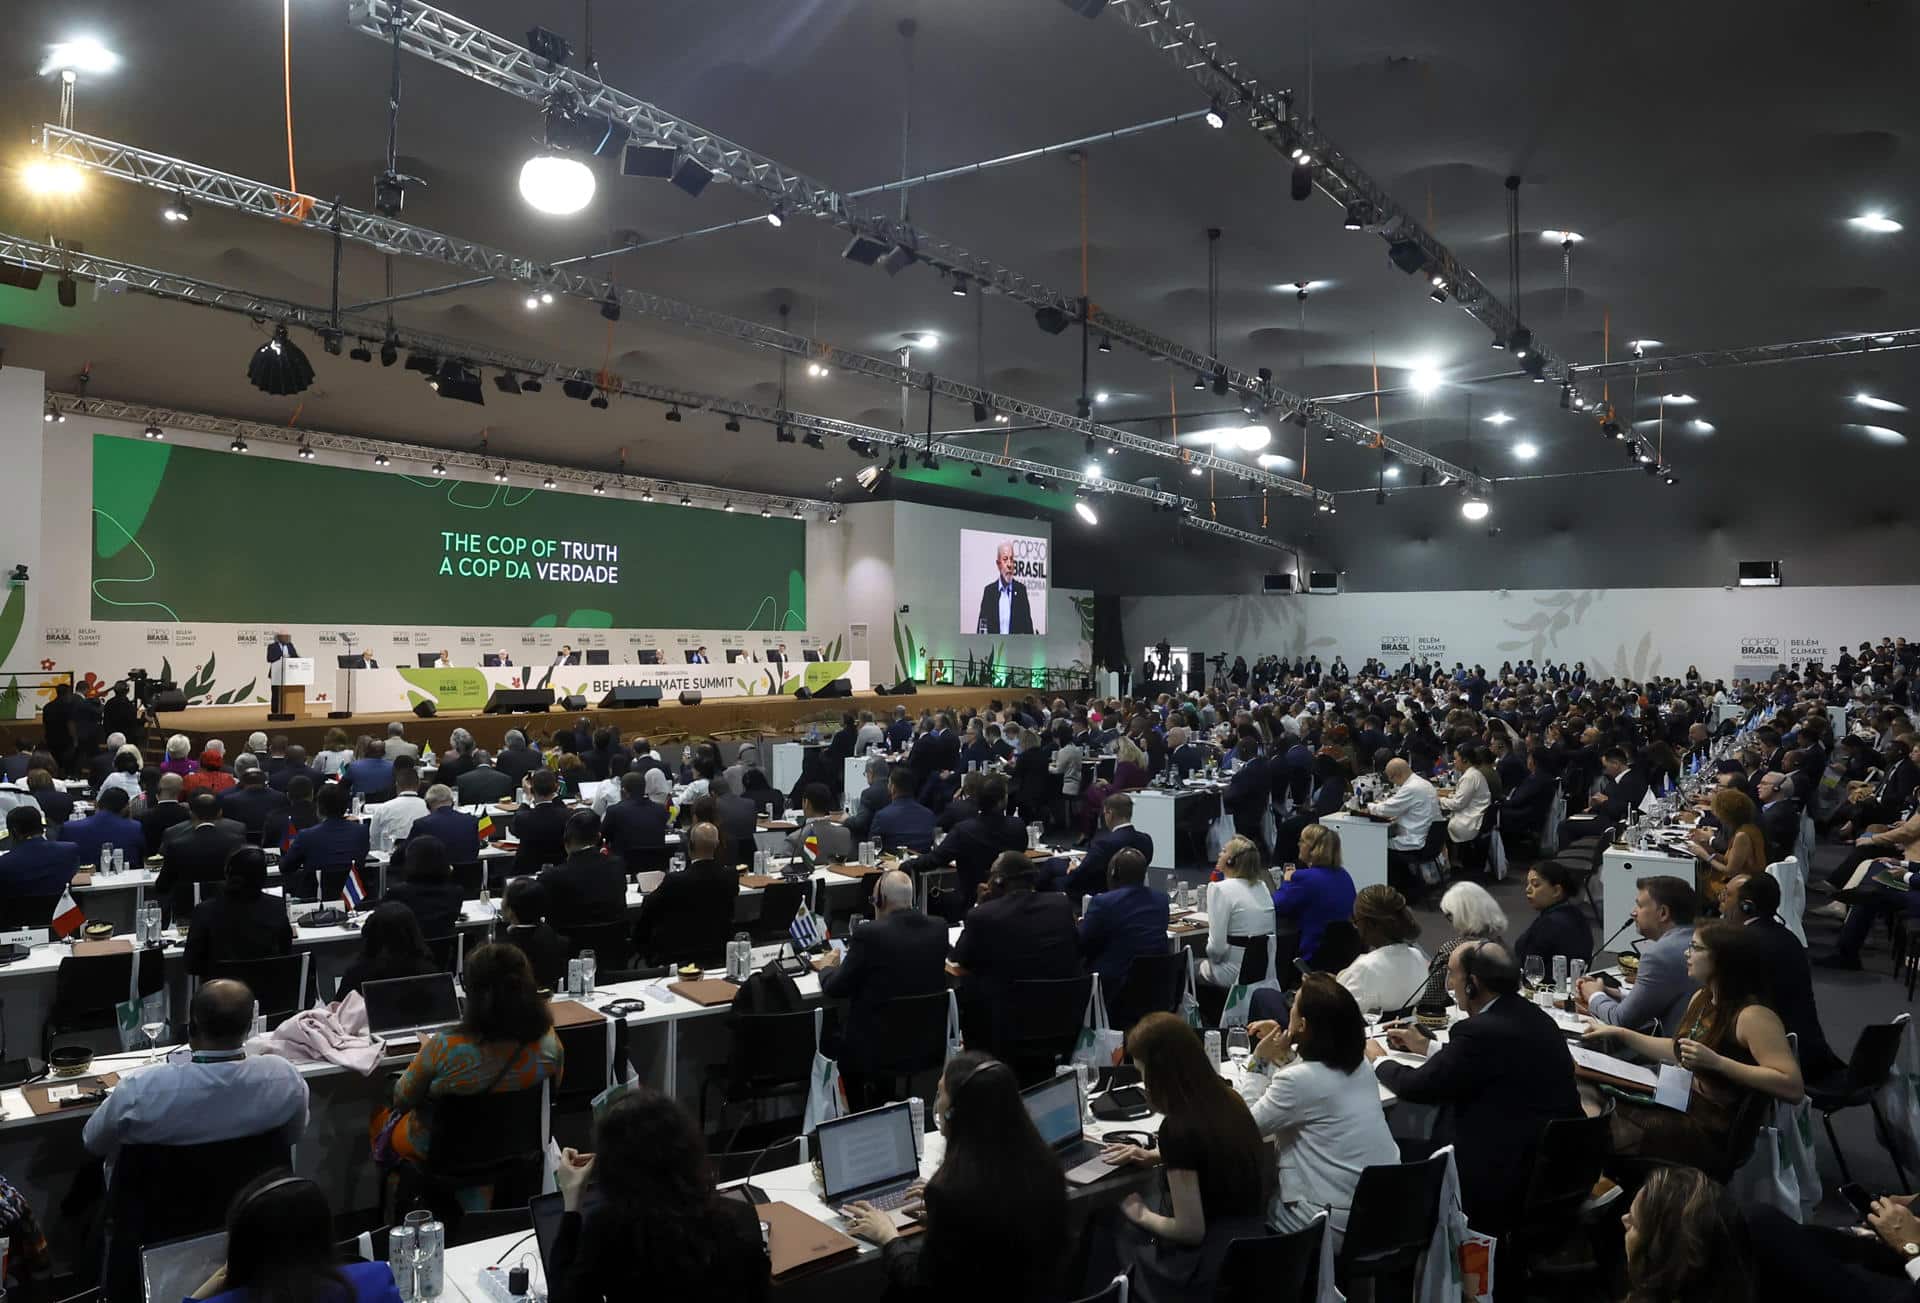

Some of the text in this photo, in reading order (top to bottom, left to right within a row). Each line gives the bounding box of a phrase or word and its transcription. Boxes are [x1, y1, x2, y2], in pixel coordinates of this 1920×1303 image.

[441, 532, 618, 562] THE COP OF TRUTH
[439, 557, 618, 584] A COP DA VERDADE
[1013, 560, 1047, 579] BRASIL
[1381, 643, 1410, 651] BRASIL
[1791, 637, 1819, 646] BELÉM
[1741, 647, 1779, 655] BRASIL
[693, 676, 734, 689] SUMMIT
